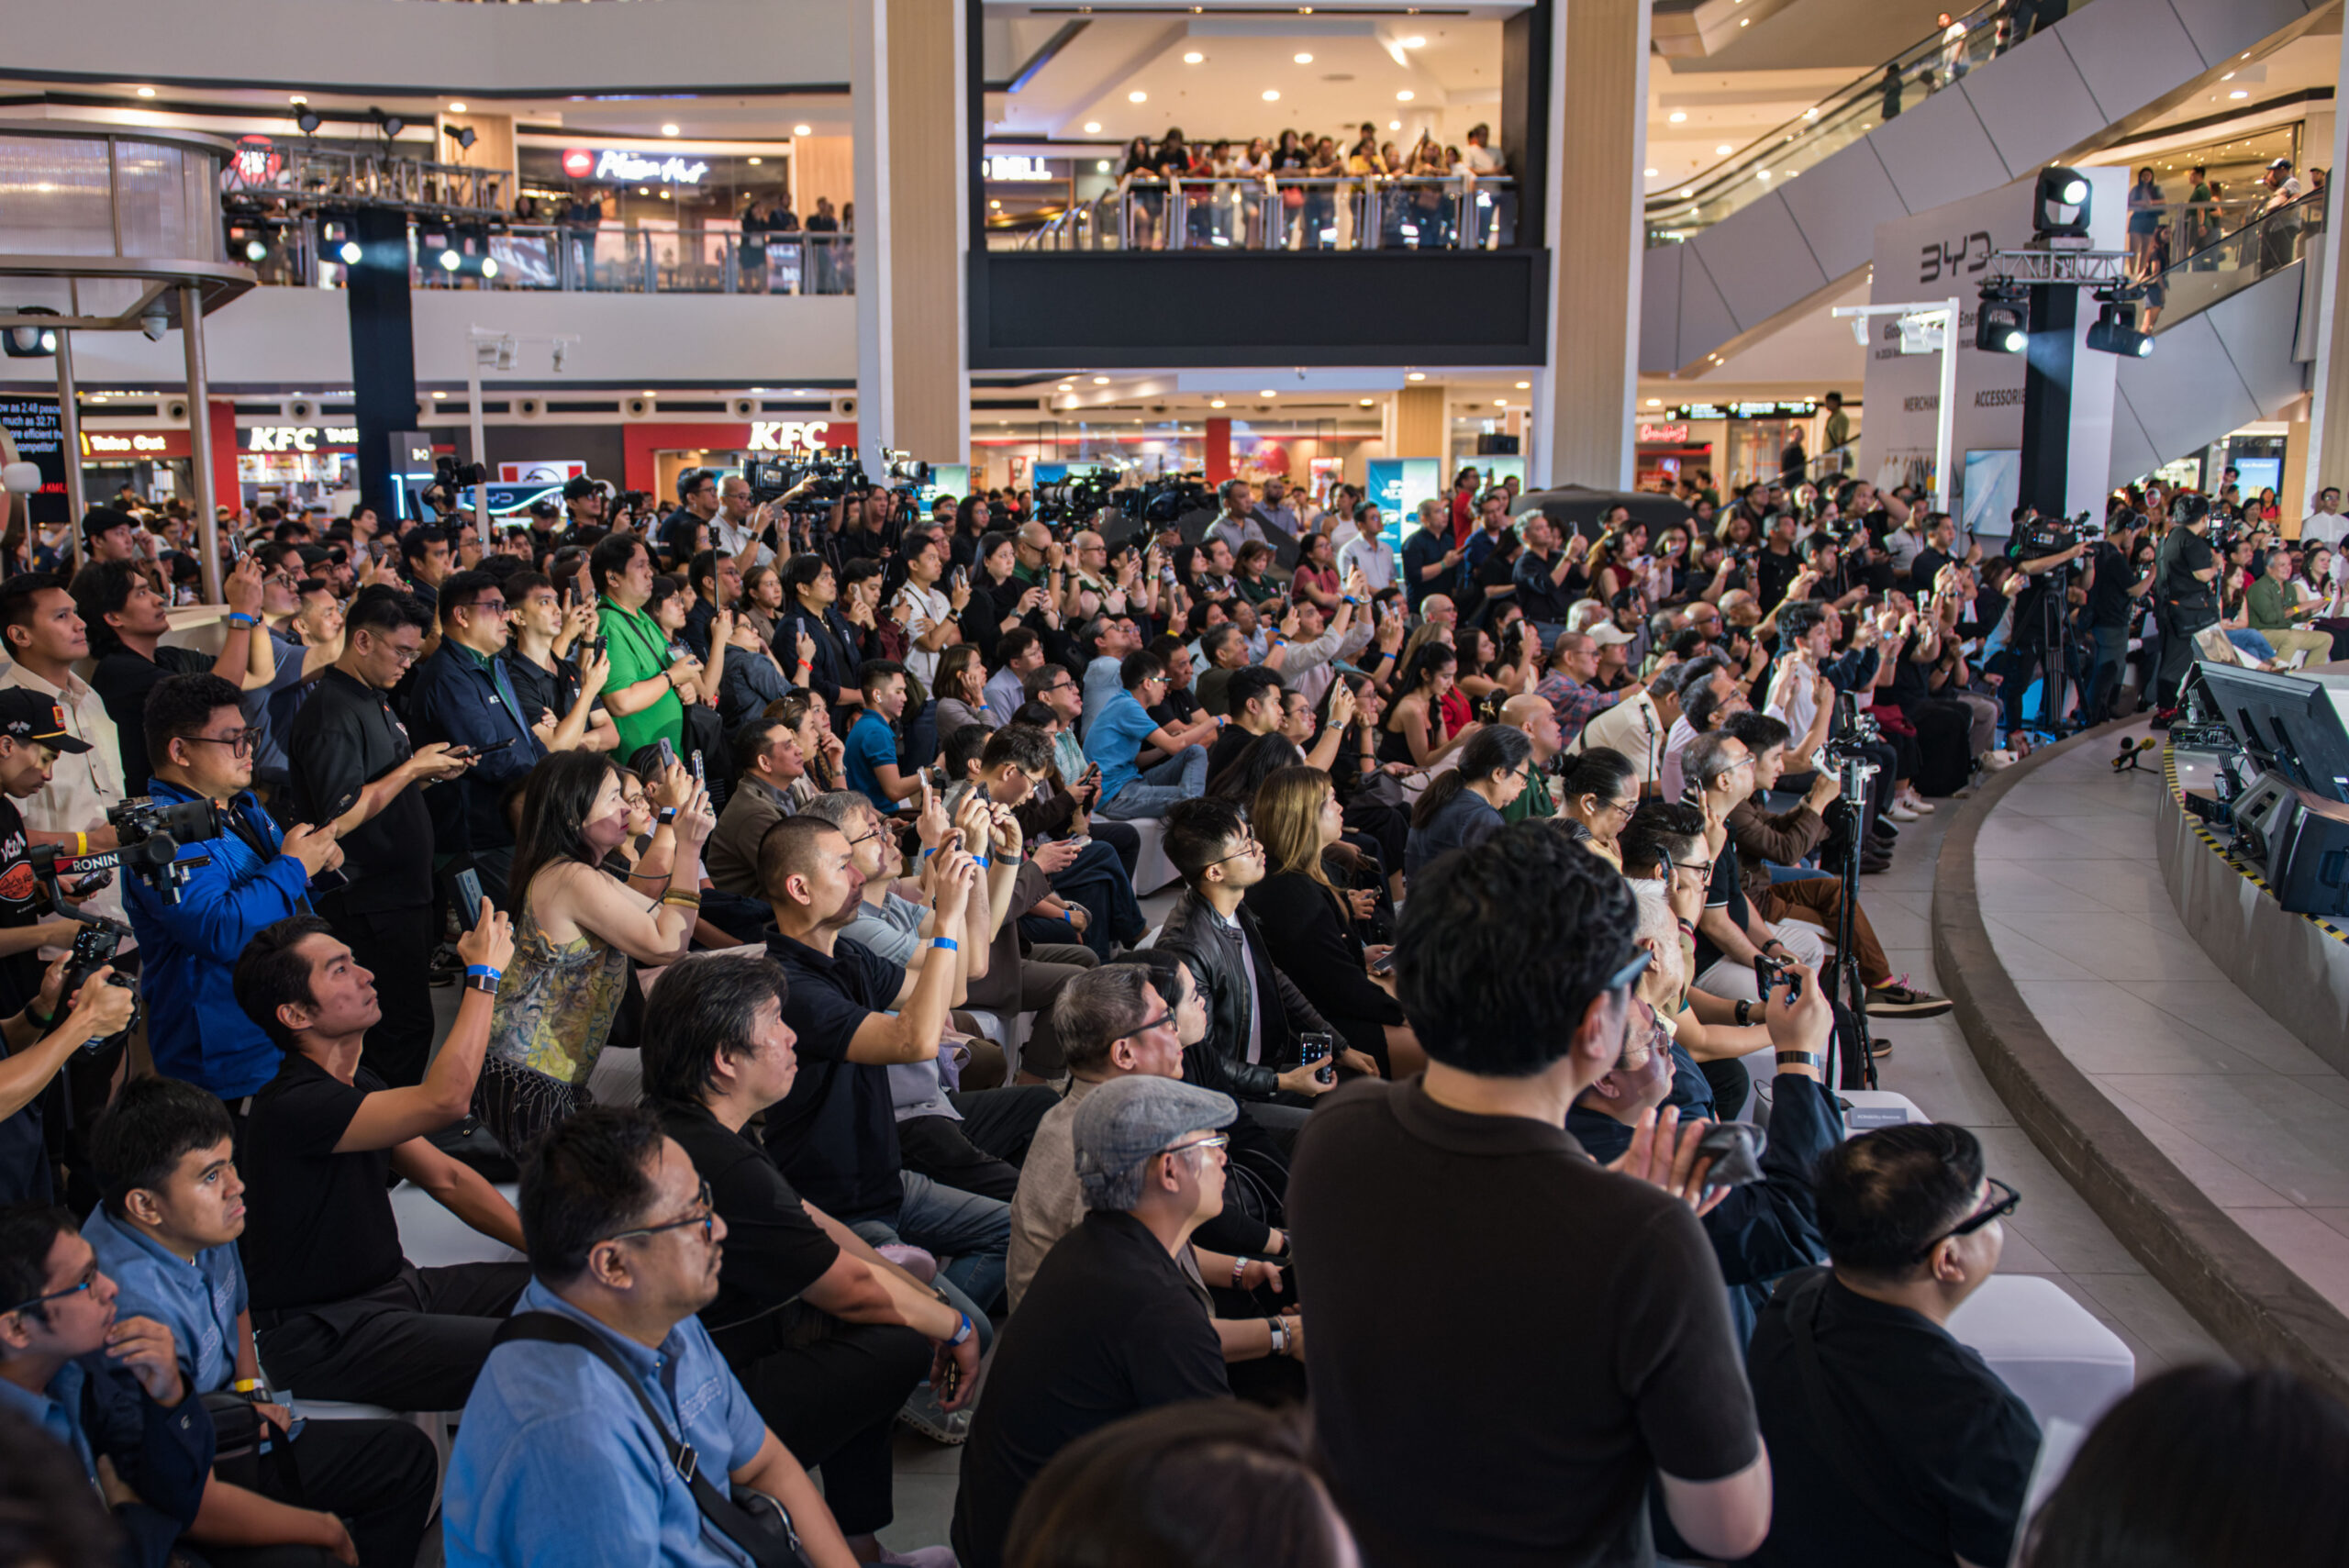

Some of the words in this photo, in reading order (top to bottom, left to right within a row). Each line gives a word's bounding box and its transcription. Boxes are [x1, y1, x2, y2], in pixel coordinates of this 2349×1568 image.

[992, 157, 1052, 181] DELL
[1920, 231, 1991, 284] BYD
[21, 402, 39, 414] 2.48
[1903, 395, 1939, 413] MERCHAN
[1975, 388, 2026, 408] ACCESSORIE
[2, 415, 24, 427] much
[36, 415, 56, 427] 32.71
[9, 429, 23, 439] ore
[249, 427, 317, 451] KFC
[748, 421, 829, 450] KFC
[72, 852, 119, 873] RONIN
